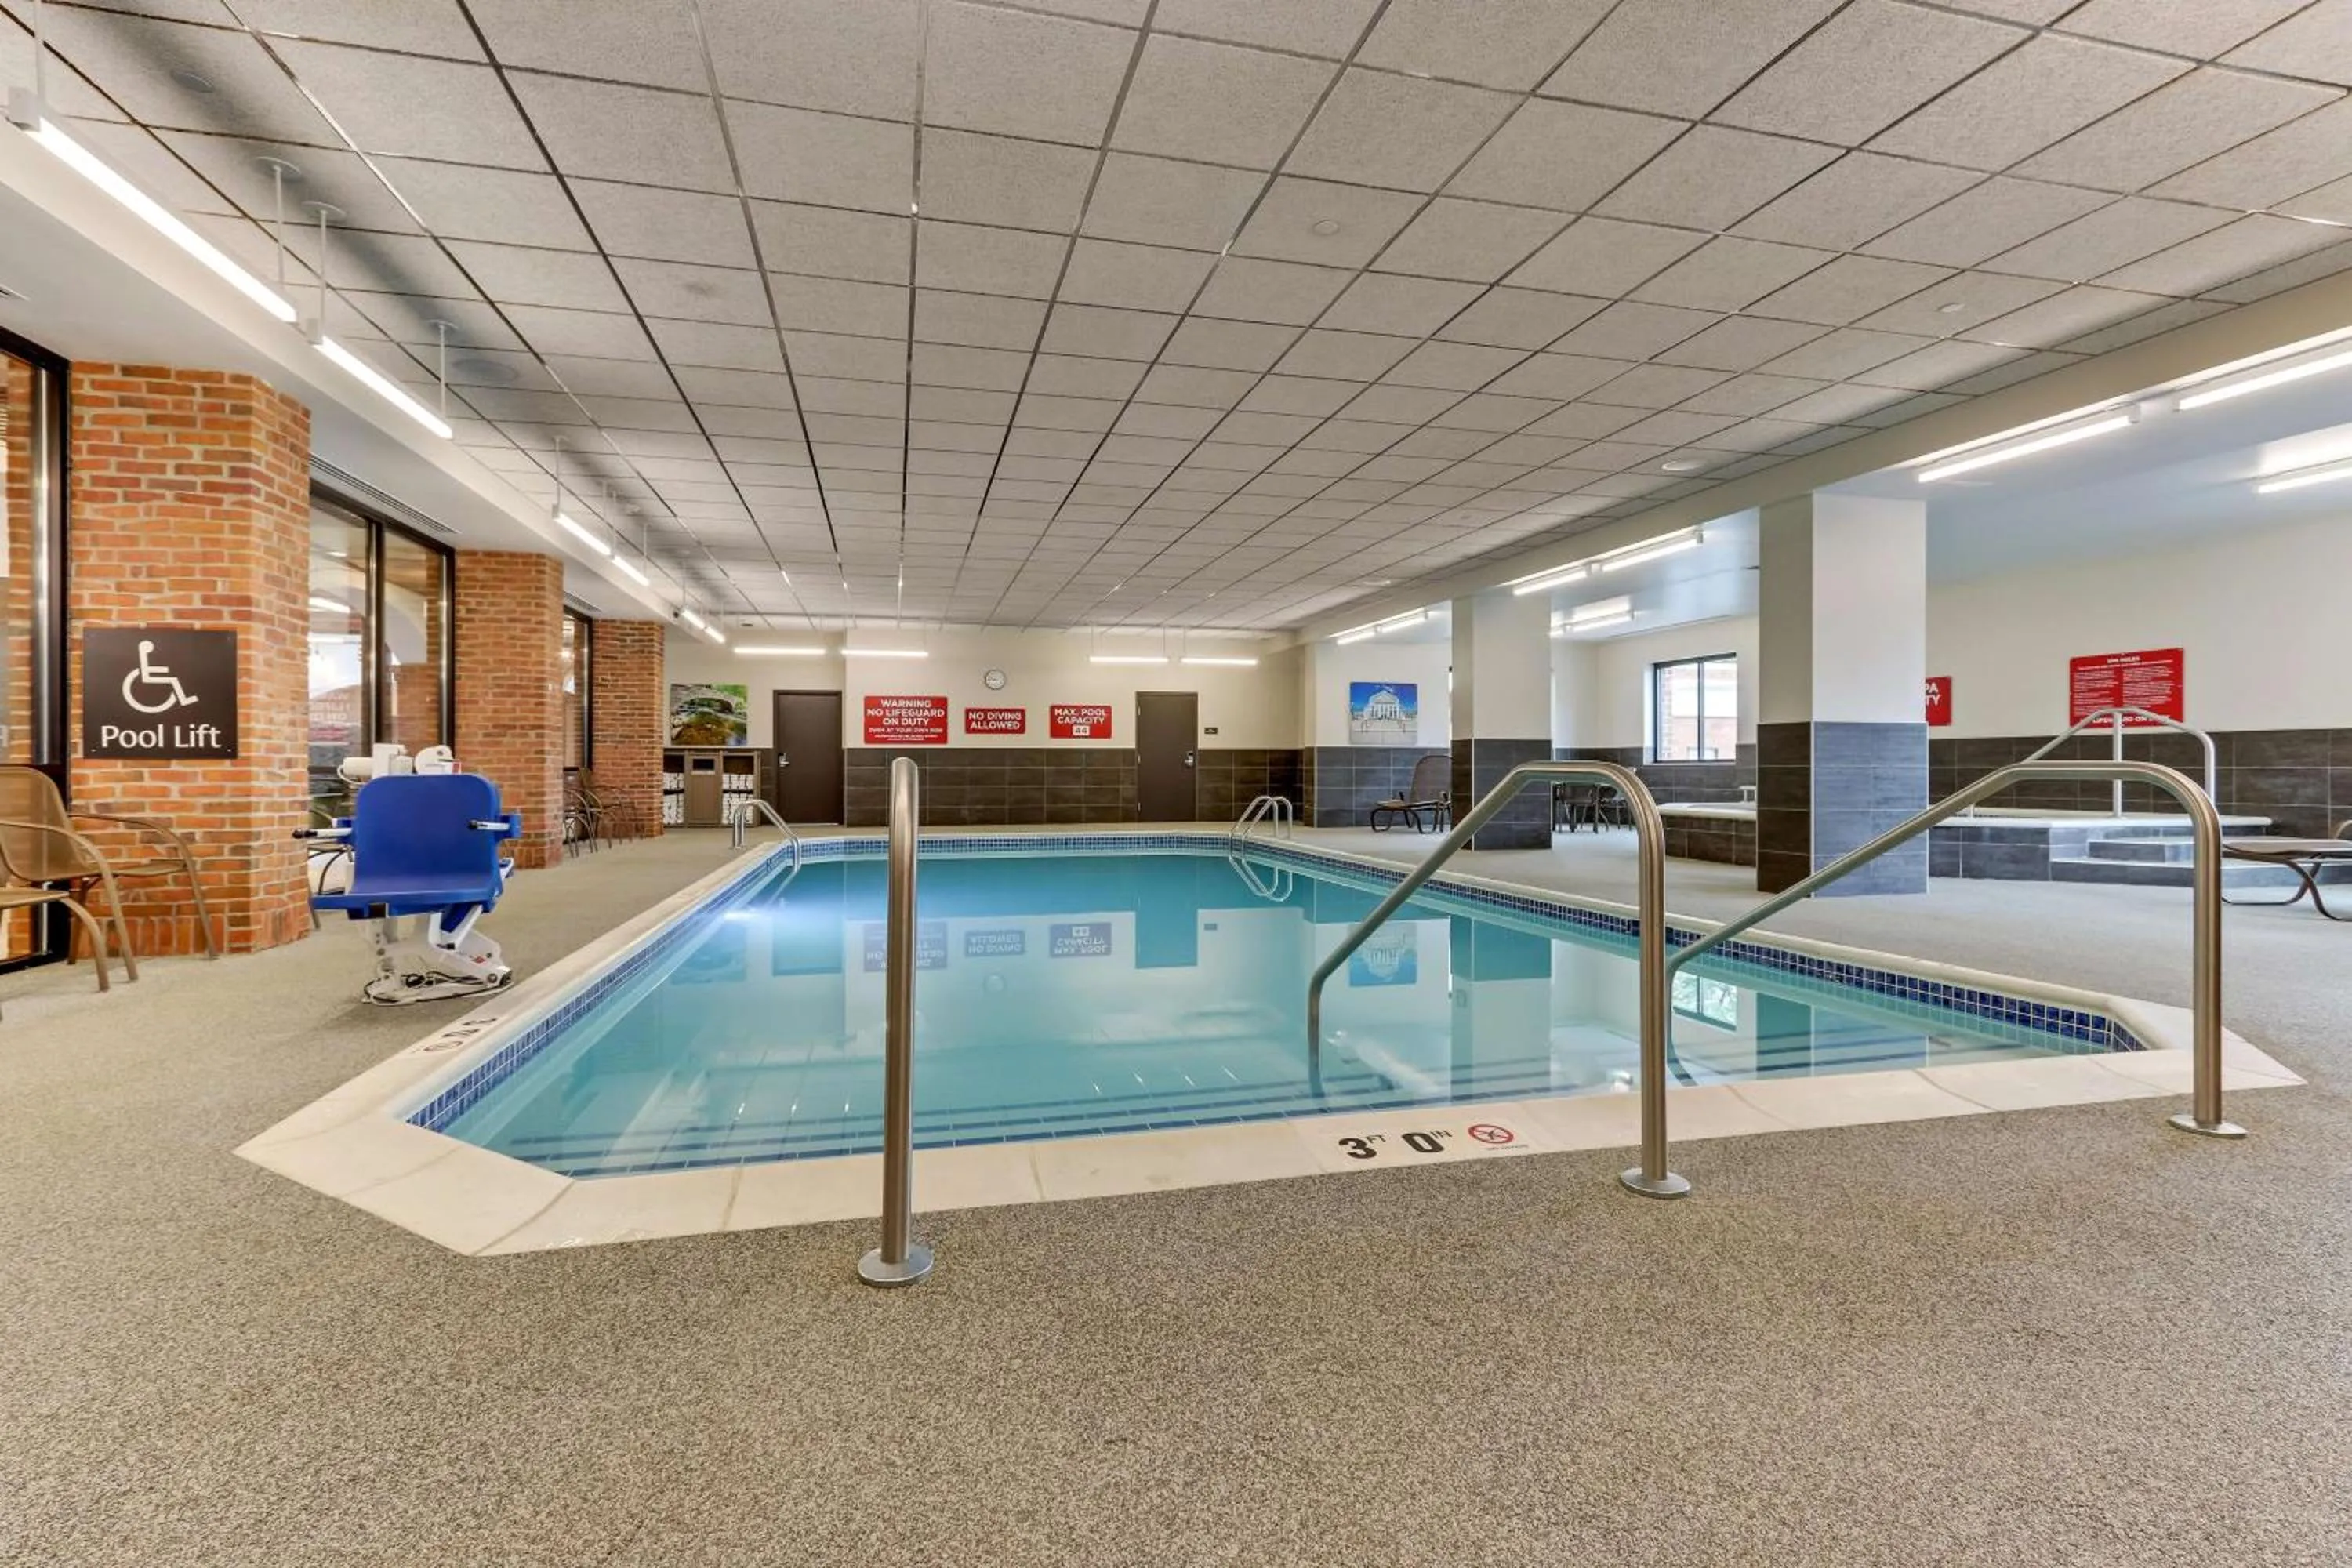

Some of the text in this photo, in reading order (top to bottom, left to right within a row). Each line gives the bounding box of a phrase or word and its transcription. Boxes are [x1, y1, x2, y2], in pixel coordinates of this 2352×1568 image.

[880, 699, 932, 708] WARNING
[866, 708, 946, 717] NO LIFEGUARD
[968, 710, 1022, 720] NO DIVING
[901, 717, 930, 726] DUTY
[1057, 716, 1105, 724] CAPACITY
[970, 720, 1021, 730] ALLOWED
[101, 724, 222, 749] Pool Lift
[1338, 1138, 1377, 1160] 3
[1401, 1132, 1445, 1153] 0
